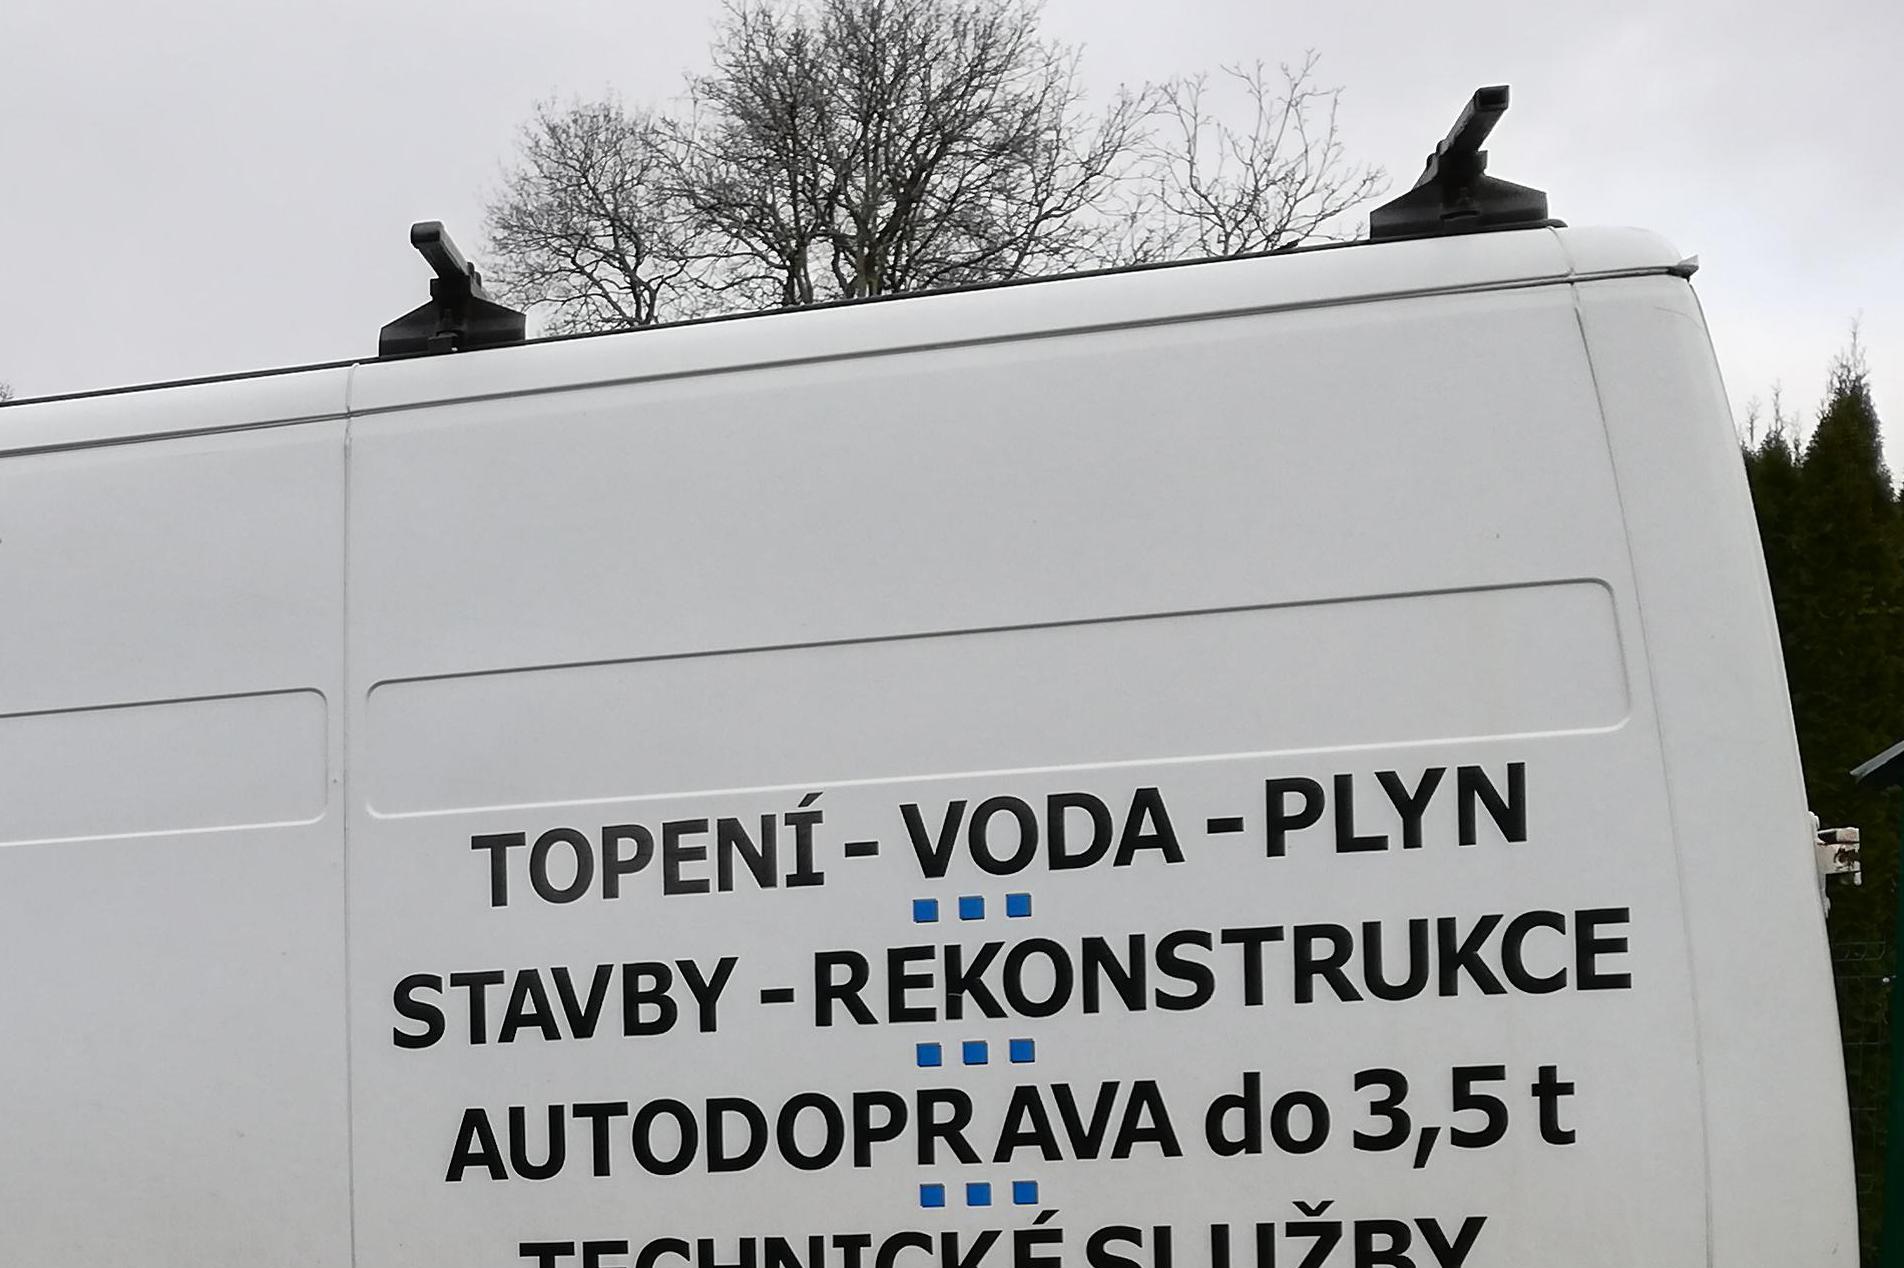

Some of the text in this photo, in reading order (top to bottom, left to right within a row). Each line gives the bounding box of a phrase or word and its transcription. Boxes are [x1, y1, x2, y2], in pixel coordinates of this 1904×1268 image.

[470, 791, 826, 908] TOPENÍ
[899, 787, 1187, 879] VODA
[1265, 761, 1528, 858] PLYN
[391, 956, 740, 1050] STAVBY
[813, 907, 1633, 1028] REKONSTRUKCE
[444, 1064, 1577, 1183] AUTODOPRAVA do 3,5 t
